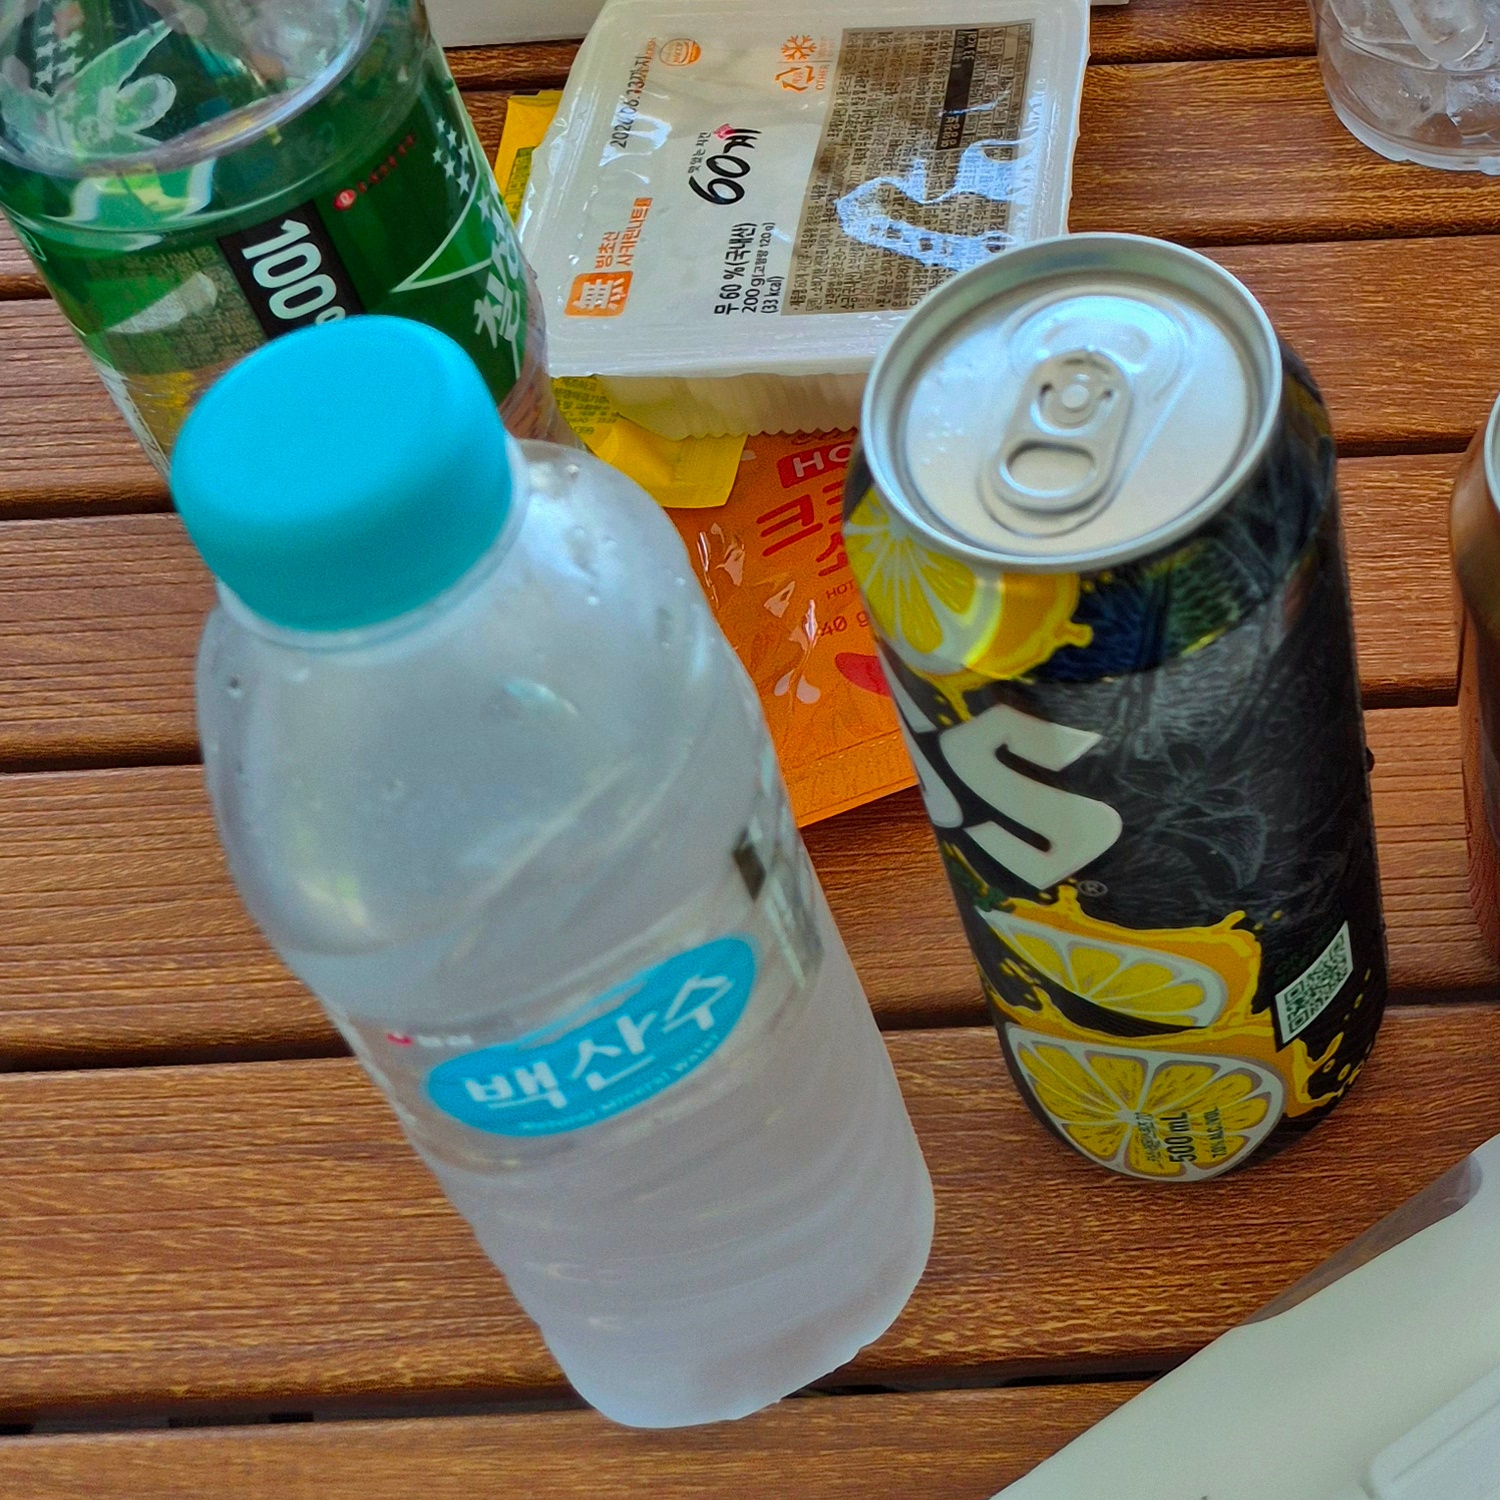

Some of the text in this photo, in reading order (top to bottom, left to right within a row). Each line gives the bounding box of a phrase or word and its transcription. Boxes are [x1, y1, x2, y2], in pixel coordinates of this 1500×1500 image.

[594, 230, 620, 270] 빙초산
[240, 217, 347, 326] 100
[719, 282, 743, 302] 60
[462, 968, 735, 1111] 백산수
[1163, 1134, 1193, 1165] 500
